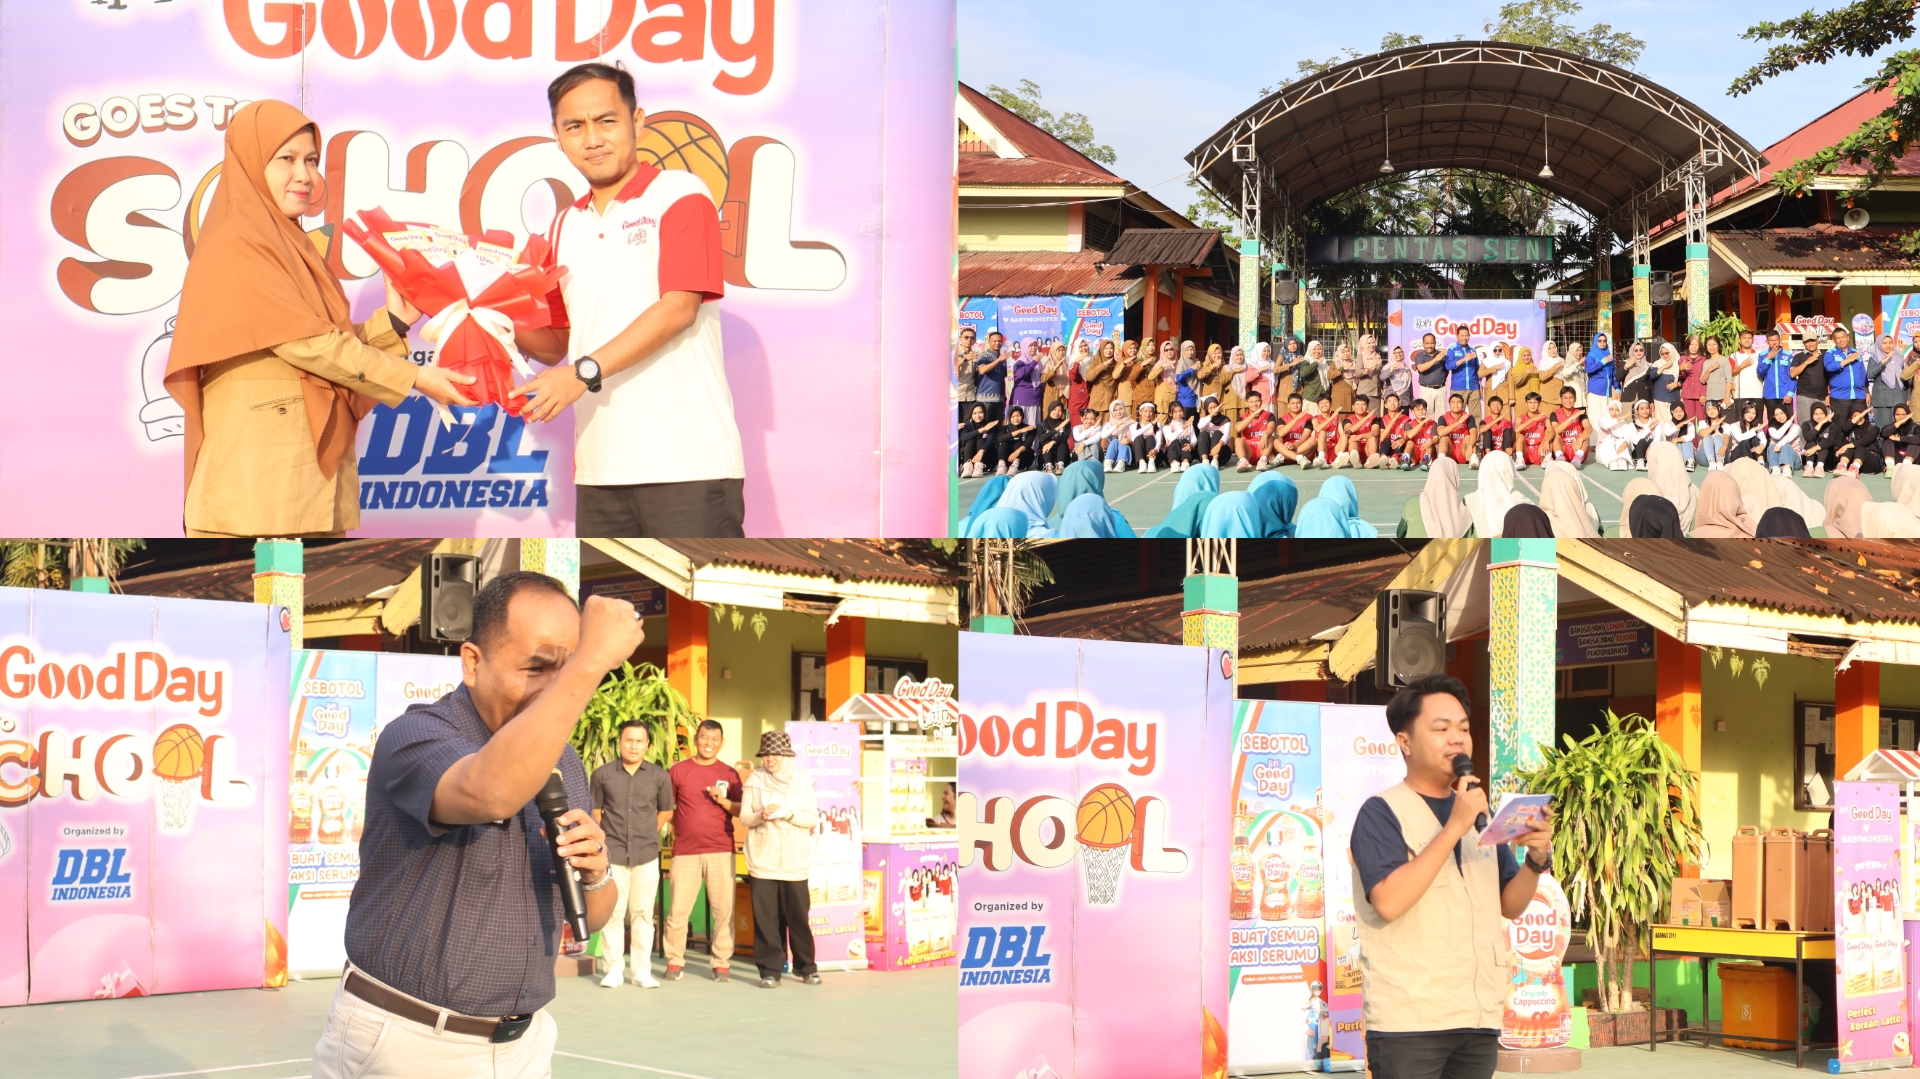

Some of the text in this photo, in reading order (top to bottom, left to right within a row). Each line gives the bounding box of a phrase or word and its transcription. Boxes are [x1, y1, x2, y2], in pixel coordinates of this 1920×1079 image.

[63, 94, 198, 148] GOES
[1353, 236, 1554, 262] PENTAS SENI
[958, 311, 984, 320] BOTOL
[1039, 303, 1058, 317] Day
[1077, 309, 1110, 317] SEBOTOL
[1483, 317, 1518, 340] Day
[358, 478, 550, 511] INDONESIA
[0, 644, 223, 718] Good Day
[303, 681, 362, 695] SEBOTOL
[404, 681, 441, 699] Good
[897, 679, 953, 703] Good Day
[314, 708, 347, 720] Good
[318, 720, 344, 734] Day
[1055, 700, 1157, 777] Day
[1243, 735, 1307, 752] SEBOTOL
[1352, 735, 1399, 756] Good
[831, 743, 851, 758] Day
[1255, 766, 1291, 779] Good
[1259, 779, 1288, 796] Day
[1851, 805, 1892, 823] Good Day
[63, 826, 125, 837] Organized by
[1841, 835, 1894, 844] BABYMONSTER
[291, 853, 323, 864] BUAT
[51, 848, 132, 886] DBL
[290, 869, 315, 882] AKSI
[51, 885, 132, 901] INDONESIA
[974, 901, 1044, 913] Organized by
[809, 916, 830, 927] rfect
[811, 927, 833, 937] rean
[1231, 929, 1316, 944] BUAT SEMUA
[1516, 926, 1554, 950] Day
[959, 925, 1052, 969] DBL
[1230, 948, 1317, 964] AKSI SERUMU
[959, 968, 1051, 986] INDONESIA
[1521, 989, 1549, 998] Originale
[1513, 996, 1556, 1007] Cappuccino
[1847, 1005, 1877, 1020] Perfect
[1849, 1013, 1903, 1033] Korean Latte!
